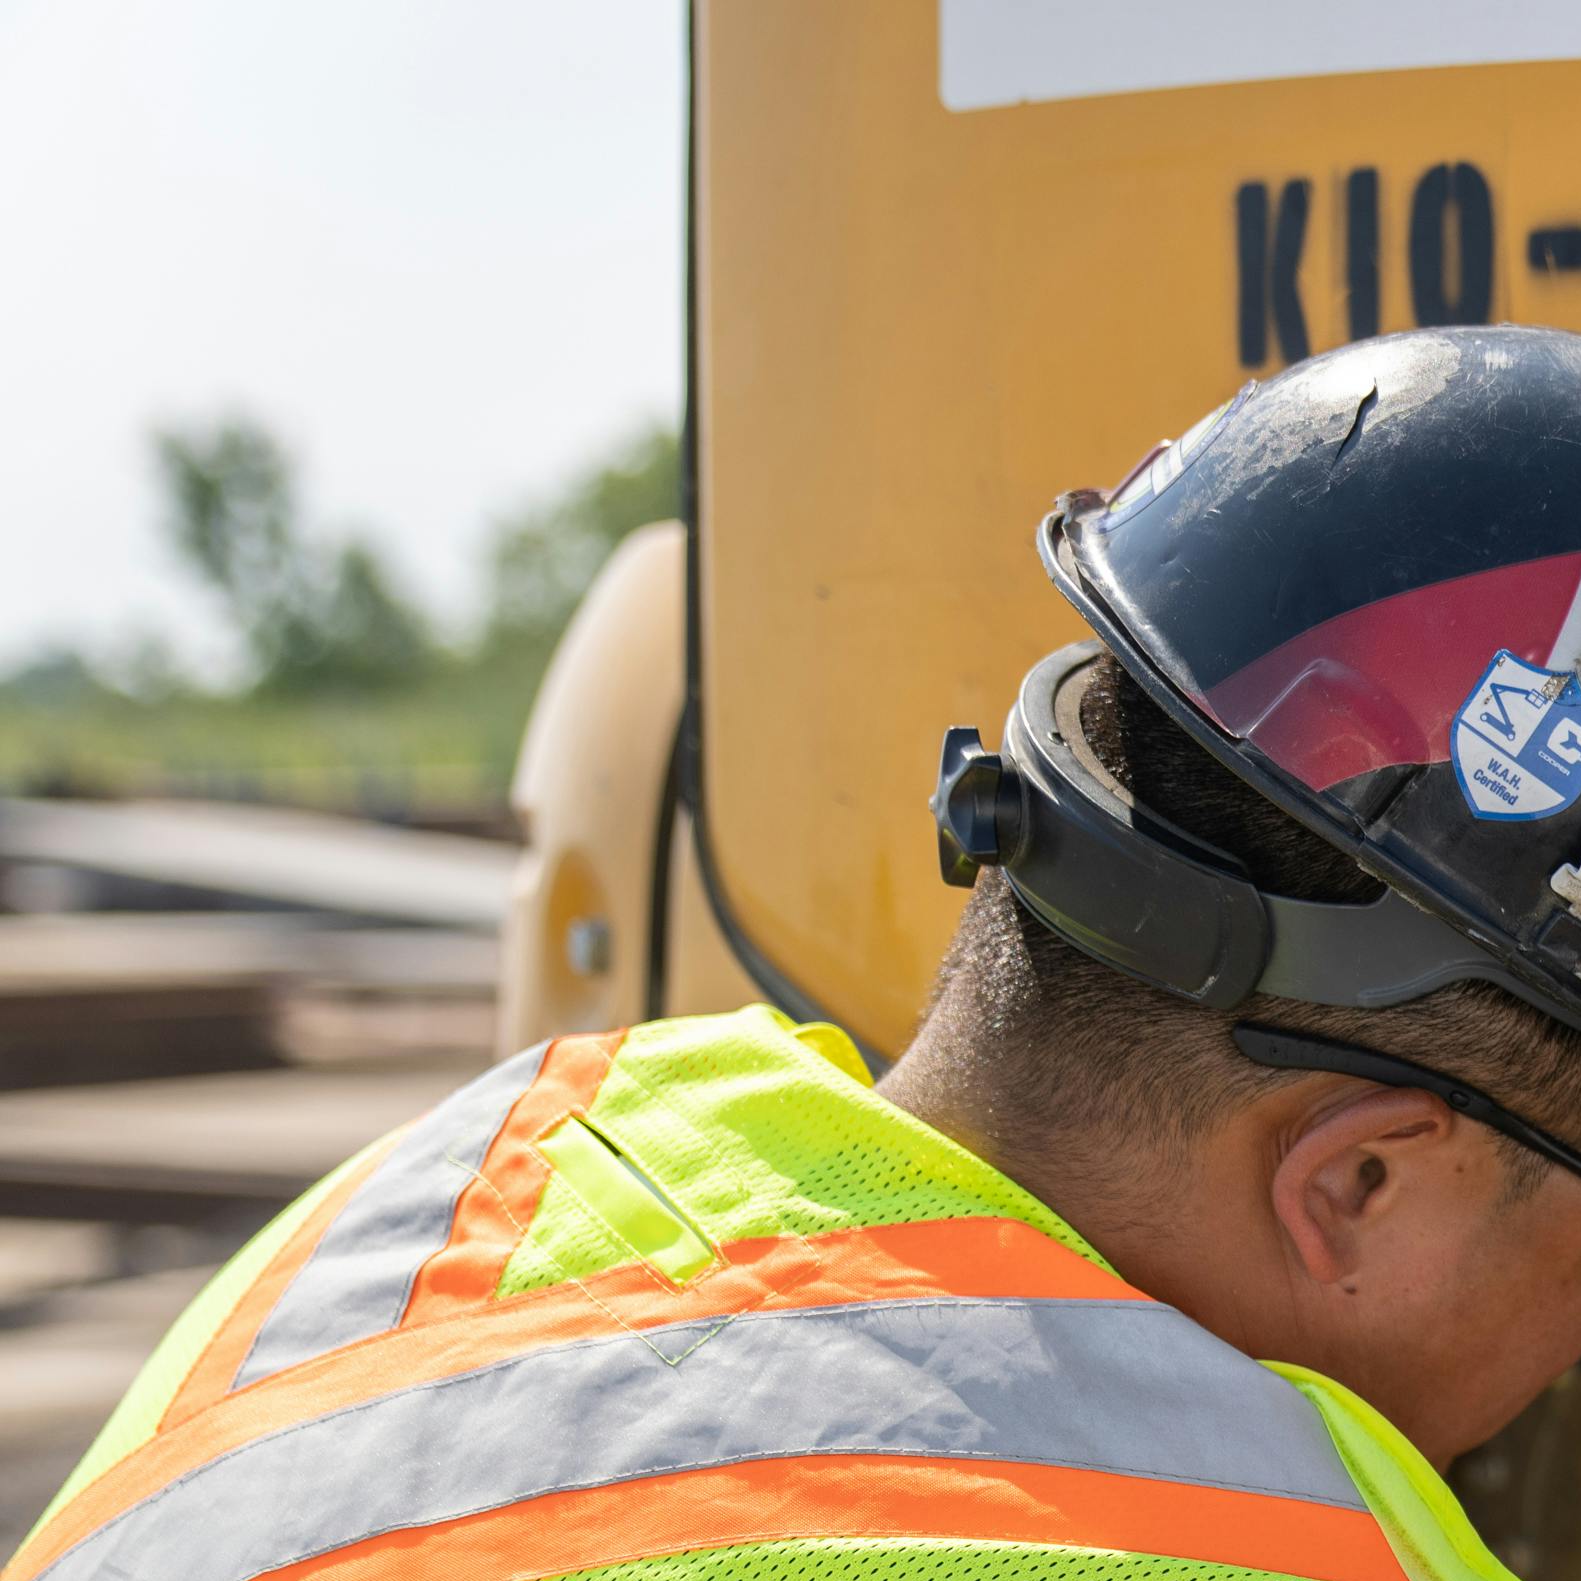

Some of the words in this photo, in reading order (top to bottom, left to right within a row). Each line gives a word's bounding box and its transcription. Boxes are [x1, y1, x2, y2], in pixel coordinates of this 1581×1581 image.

[1487, 757, 1521, 790] W.A.H.
[1537, 750, 1571, 776] COOPER
[1473, 768, 1519, 806] Certified
